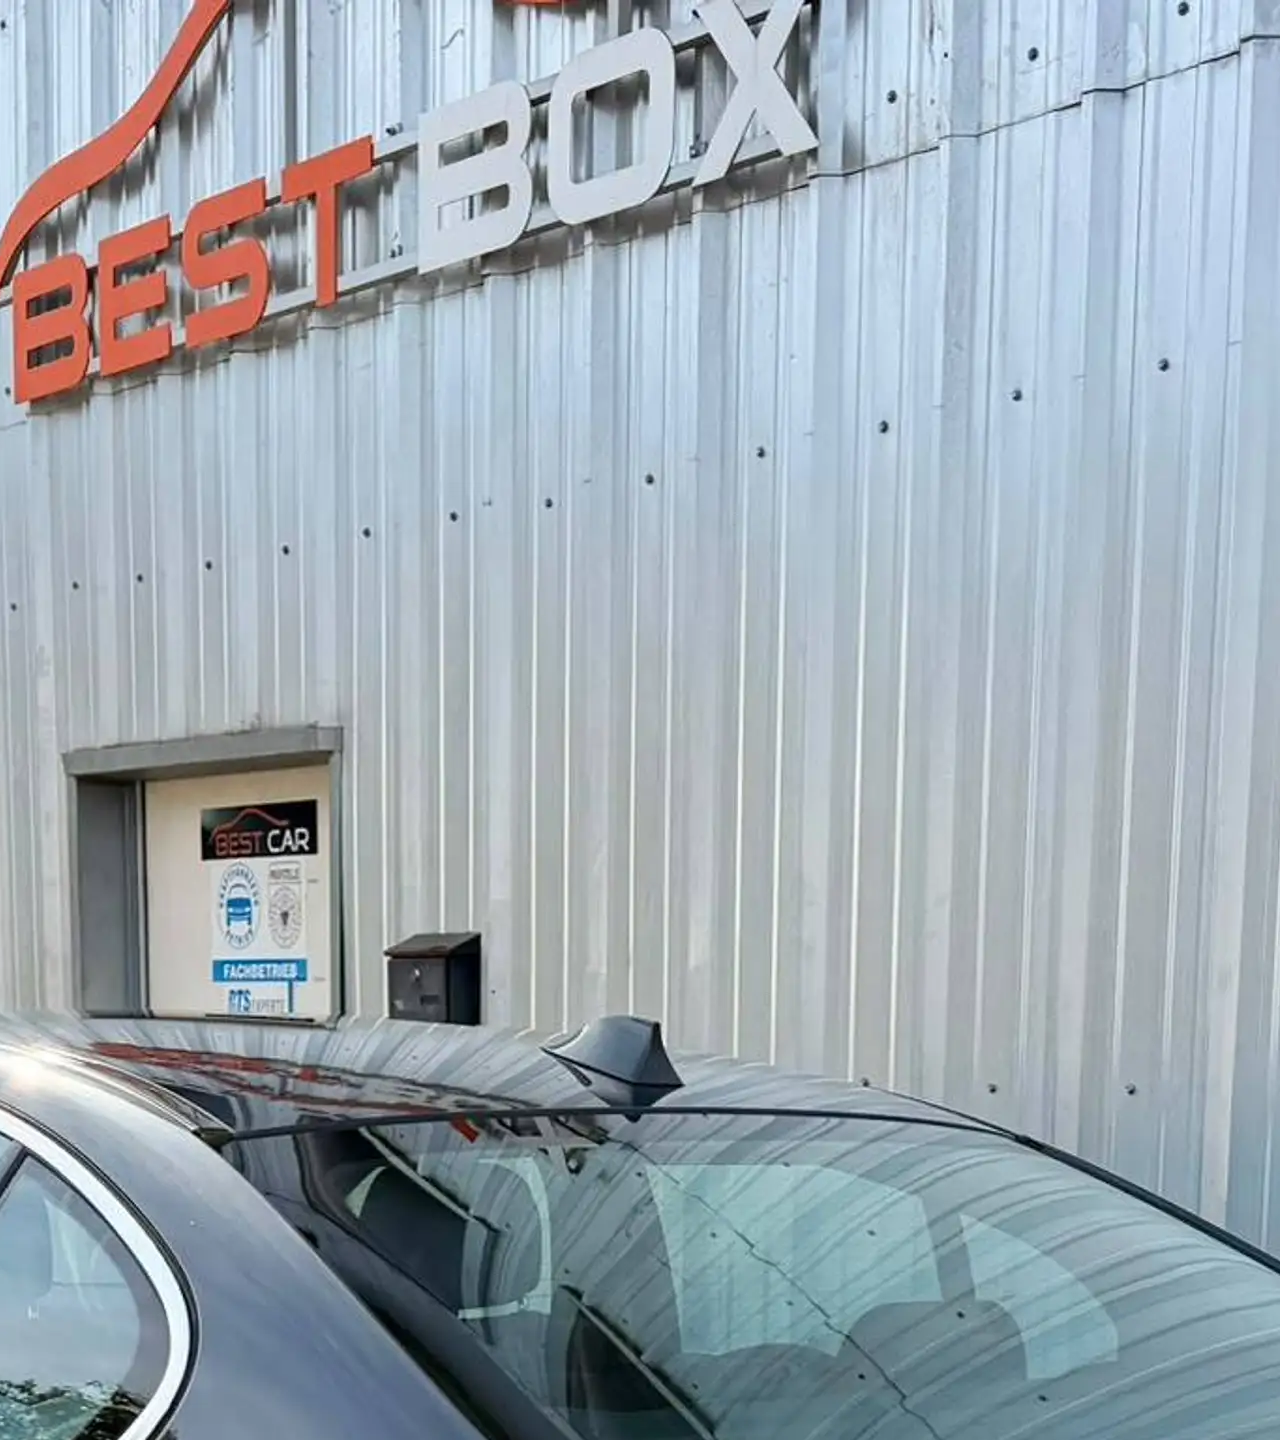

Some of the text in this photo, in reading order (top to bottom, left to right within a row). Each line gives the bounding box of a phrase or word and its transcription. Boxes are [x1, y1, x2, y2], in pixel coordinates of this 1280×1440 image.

[13, 0, 819, 404] BEST BOX
[214, 827, 310, 857] BEST CAR
